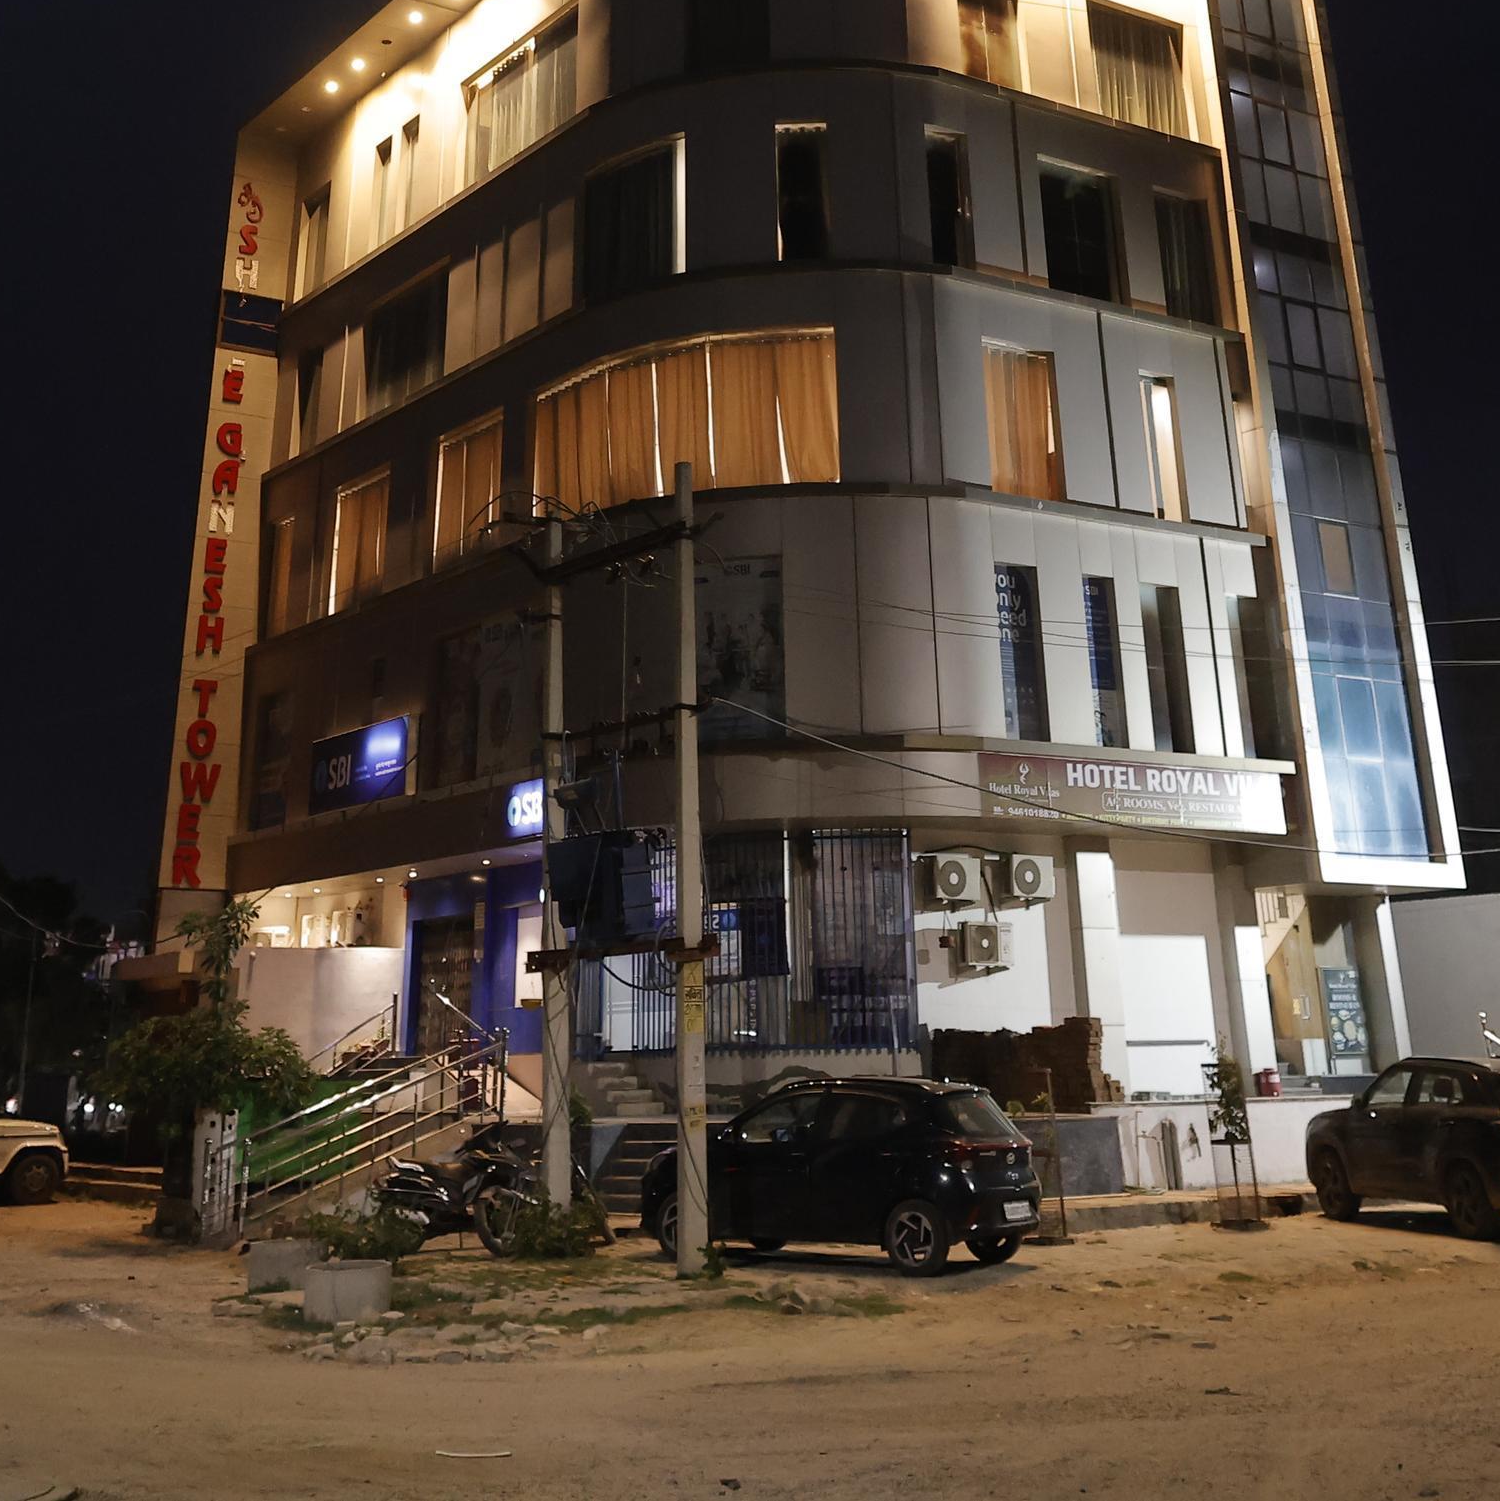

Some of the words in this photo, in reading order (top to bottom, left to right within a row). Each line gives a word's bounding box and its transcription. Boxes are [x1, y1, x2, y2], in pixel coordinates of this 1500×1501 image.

[997, 574, 1016, 589] ou
[999, 590, 1022, 611] nly
[1001, 609, 1027, 627] eed
[1002, 628, 1020, 643] ne
[327, 753, 352, 790] SBI
[1066, 763, 1142, 792] HOTEL
[1145, 768, 1221, 796] ROYAL
[172, 678, 222, 888] TOWER
[988, 782, 1012, 795] Hotel
[1013, 784, 1038, 798] Royal
[522, 791, 543, 824] SB
